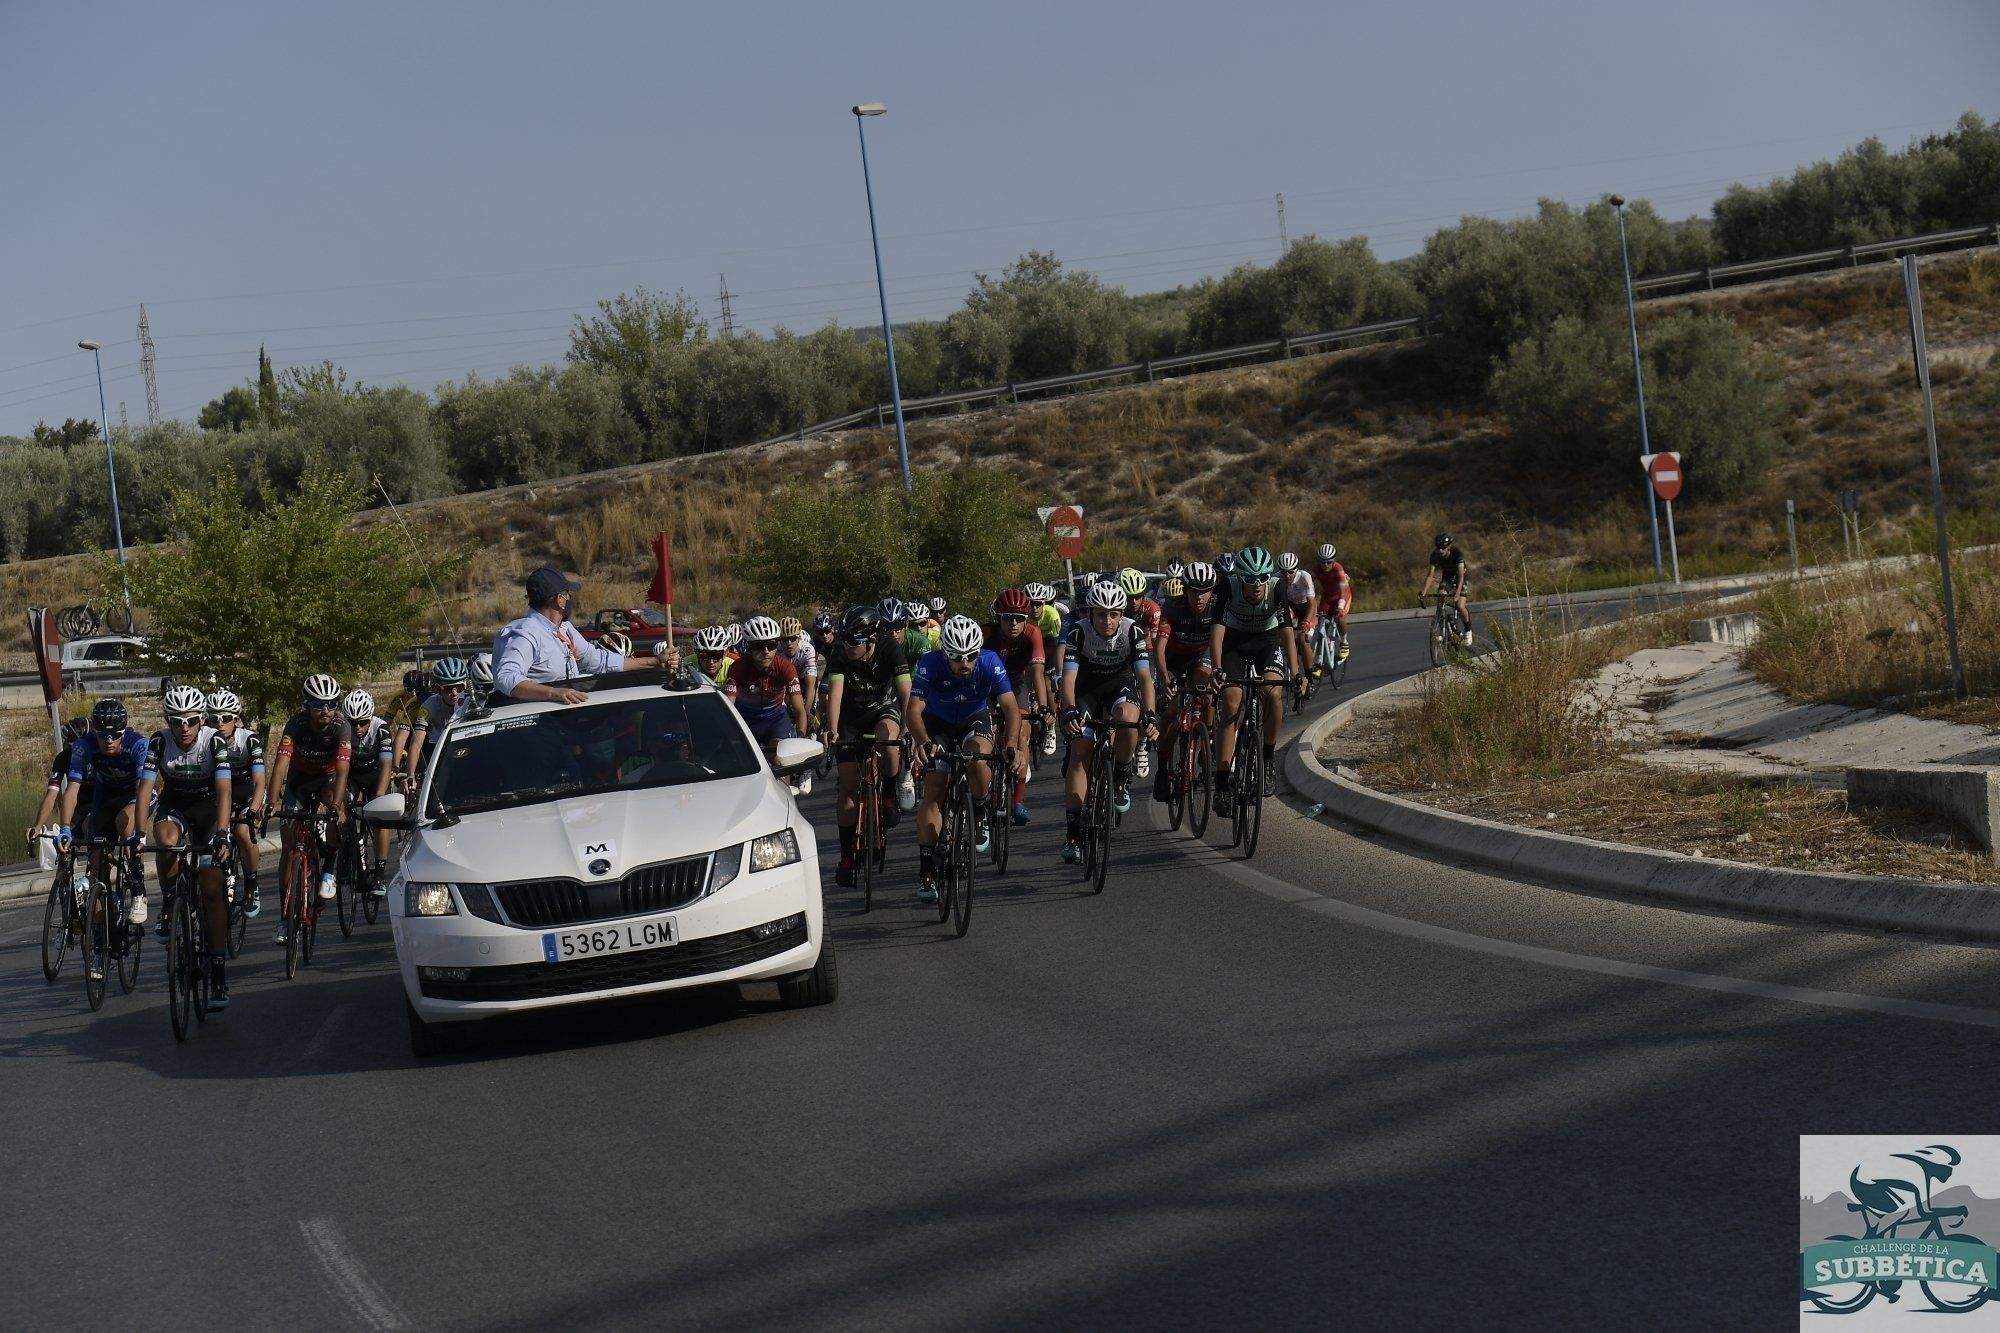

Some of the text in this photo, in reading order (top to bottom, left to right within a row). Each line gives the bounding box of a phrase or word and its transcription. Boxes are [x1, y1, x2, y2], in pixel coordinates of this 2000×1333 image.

[585, 843, 610, 855] M
[562, 921, 672, 956] 5362 LGM
